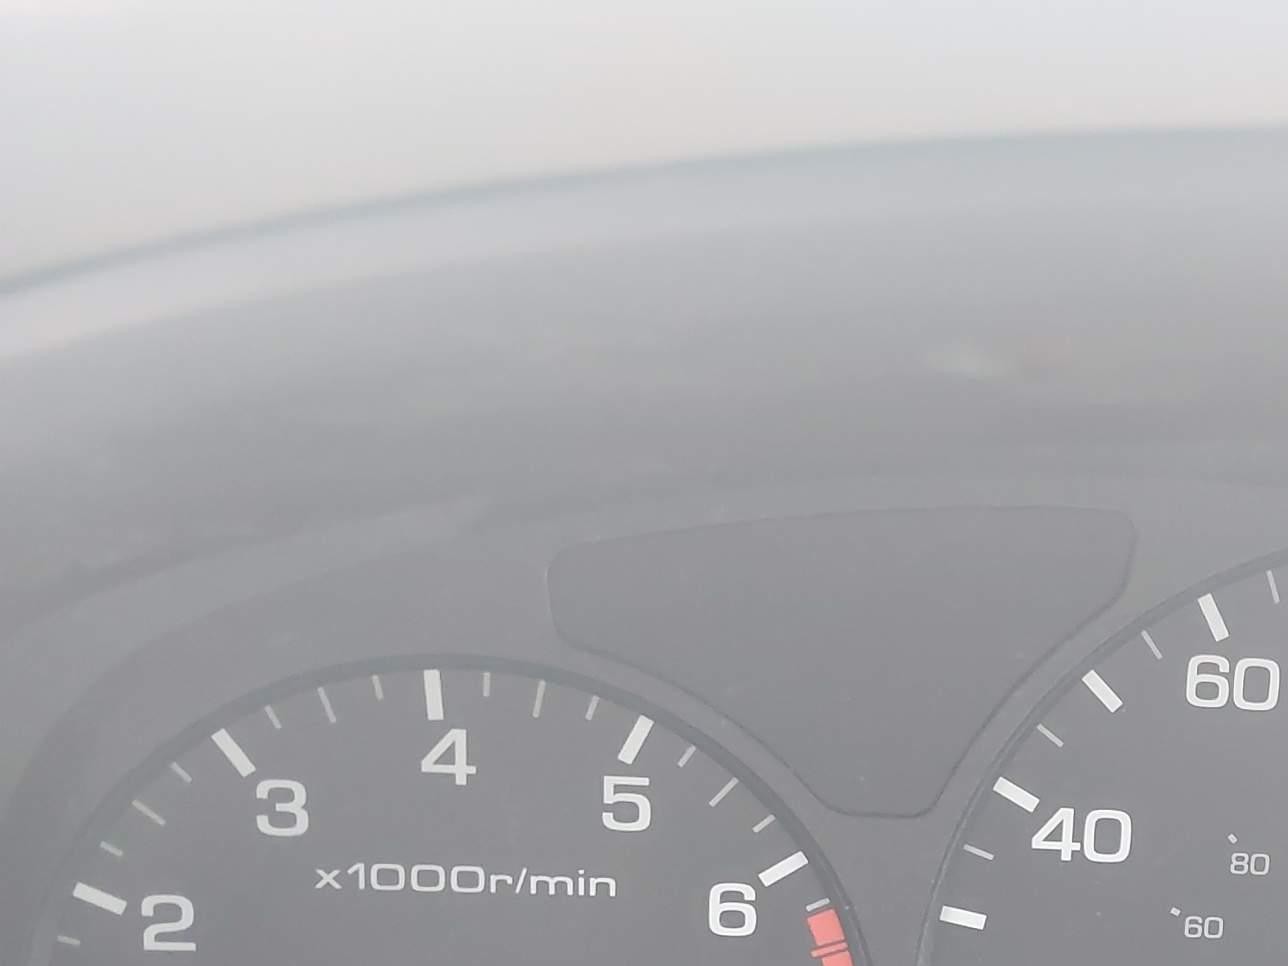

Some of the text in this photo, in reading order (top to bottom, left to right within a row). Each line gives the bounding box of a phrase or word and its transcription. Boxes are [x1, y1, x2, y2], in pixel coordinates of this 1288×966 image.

[1186, 655, 1280, 711] 60
[420, 729, 477, 785] 4
[255, 779, 310, 836] 3
[603, 776, 652, 831] 5
[1031, 808, 1132, 863] 40
[1230, 852, 1270, 876] 80
[141, 894, 196, 951] 2
[707, 883, 757, 937] 6
[1184, 916, 1224, 938] 60
